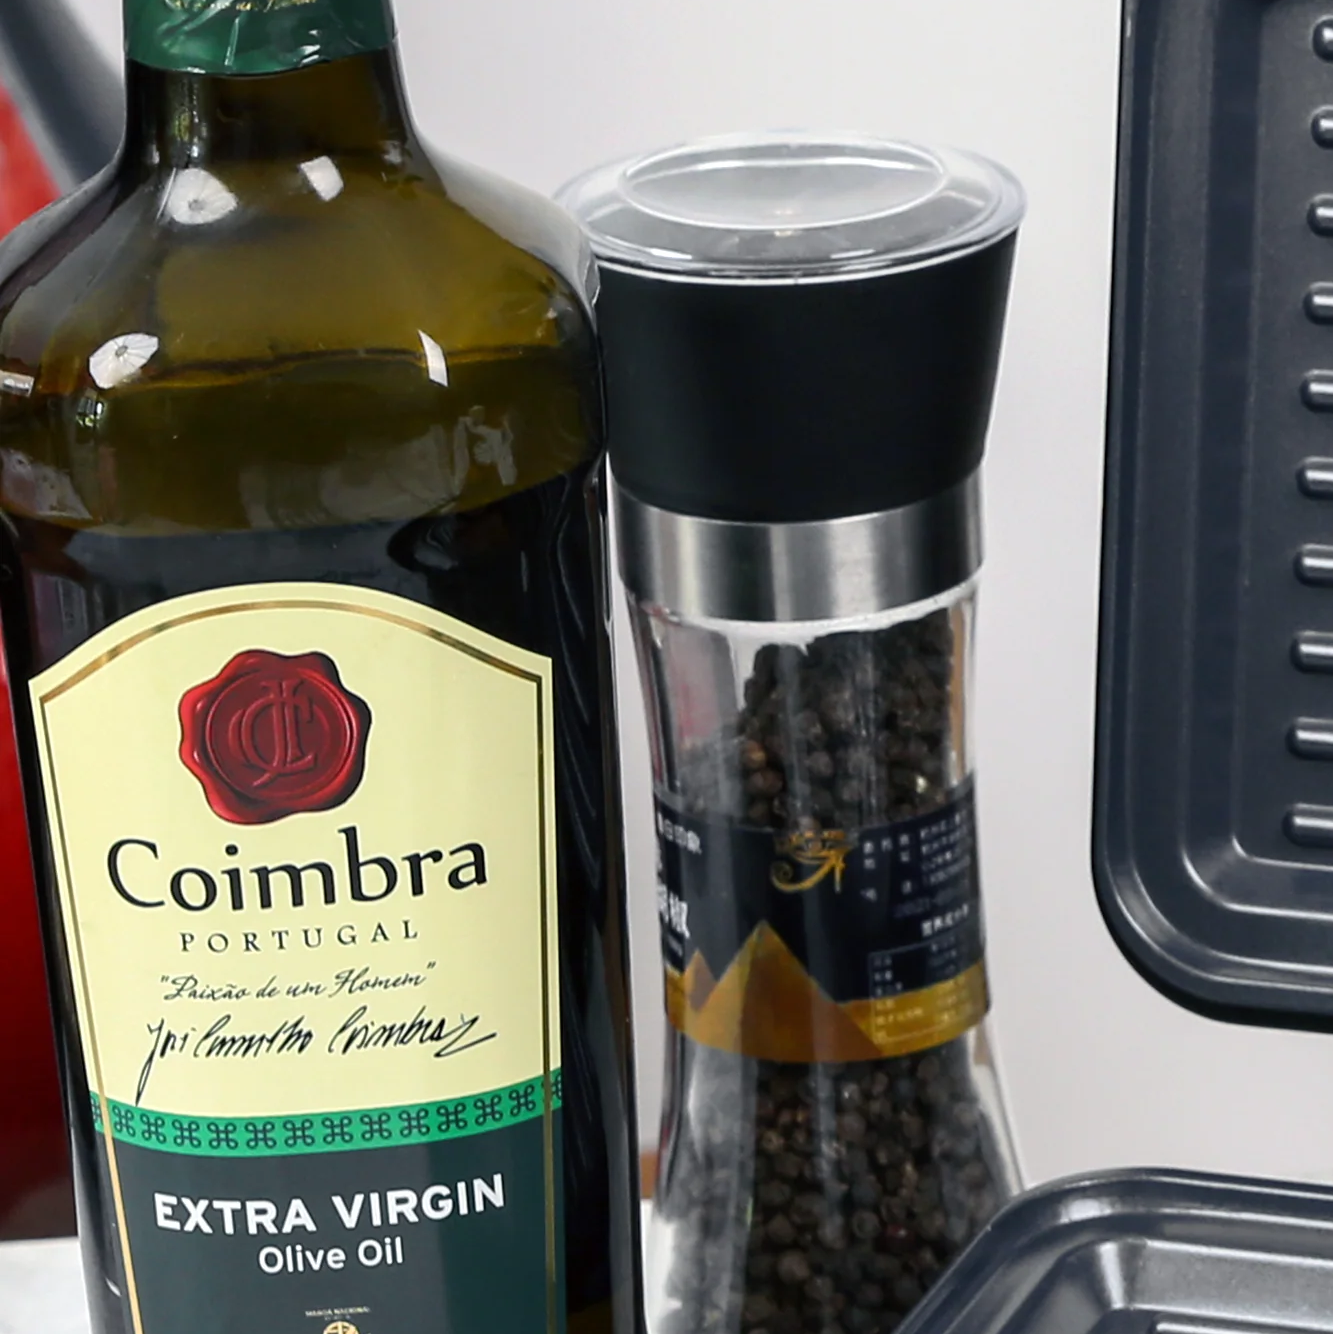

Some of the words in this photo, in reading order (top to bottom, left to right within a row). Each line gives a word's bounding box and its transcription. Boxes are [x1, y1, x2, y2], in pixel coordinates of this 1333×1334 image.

[107, 825, 488, 913] Coimbra
[179, 920, 419, 954] PORTUGAL
[255, 976, 281, 999] de
[286, 985, 326, 998] um
[153, 1190, 317, 1236] EXTRA
[331, 1173, 506, 1231] VIRGIN
[258, 1242, 347, 1275] Olive
[357, 1236, 404, 1267] Oil
